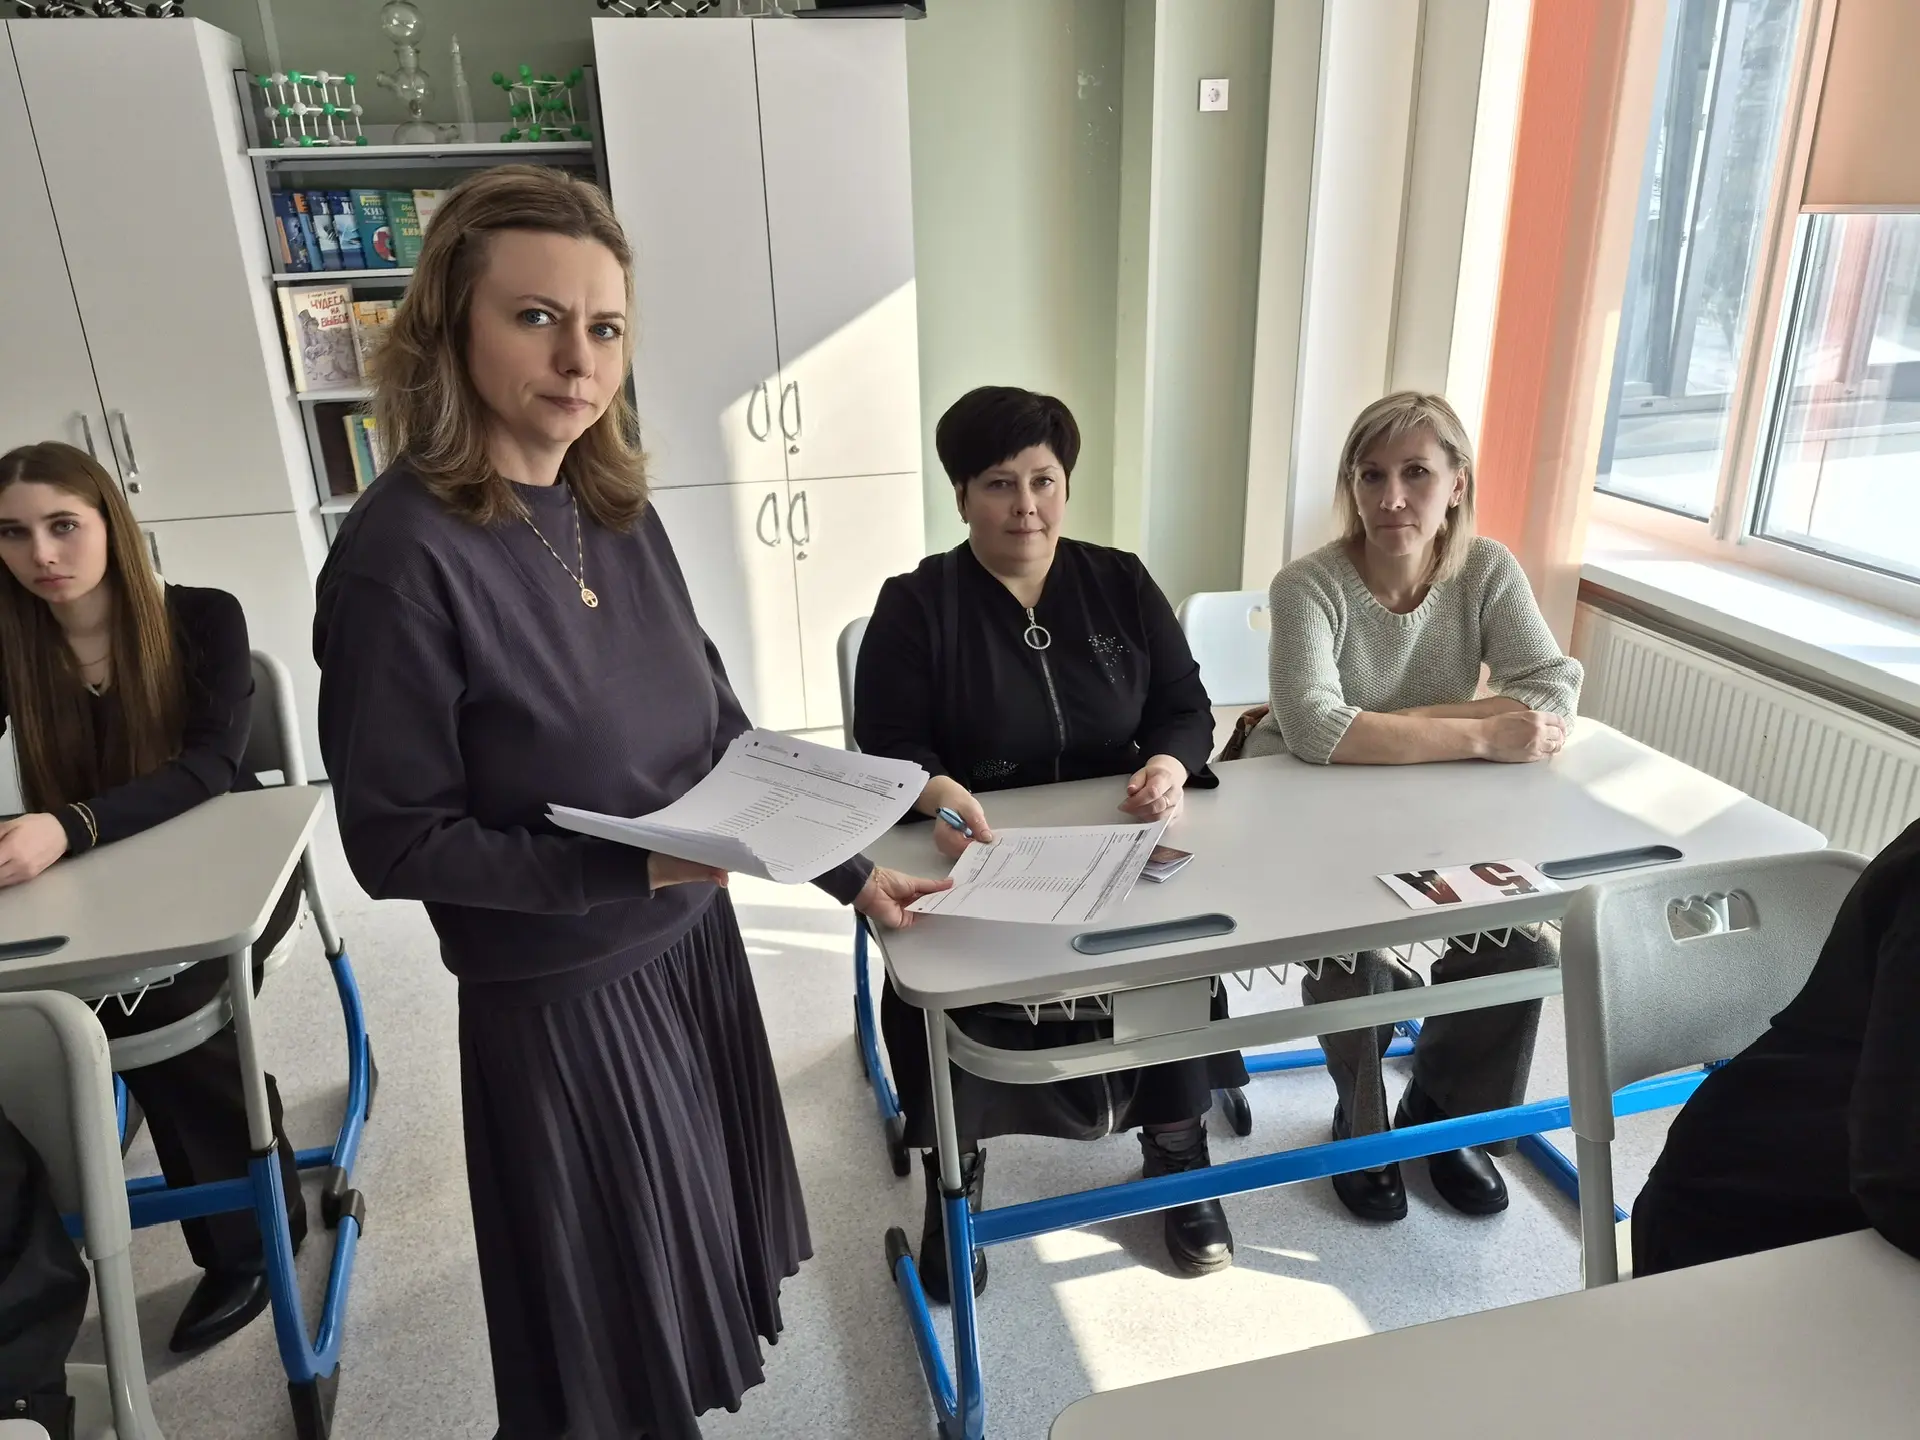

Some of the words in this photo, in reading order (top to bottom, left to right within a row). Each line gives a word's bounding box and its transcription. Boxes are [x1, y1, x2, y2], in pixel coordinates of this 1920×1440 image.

[310, 294, 346, 310] ЧУДЕСА
[330, 307, 341, 315] НА
[1469, 862, 1539, 897] 5
